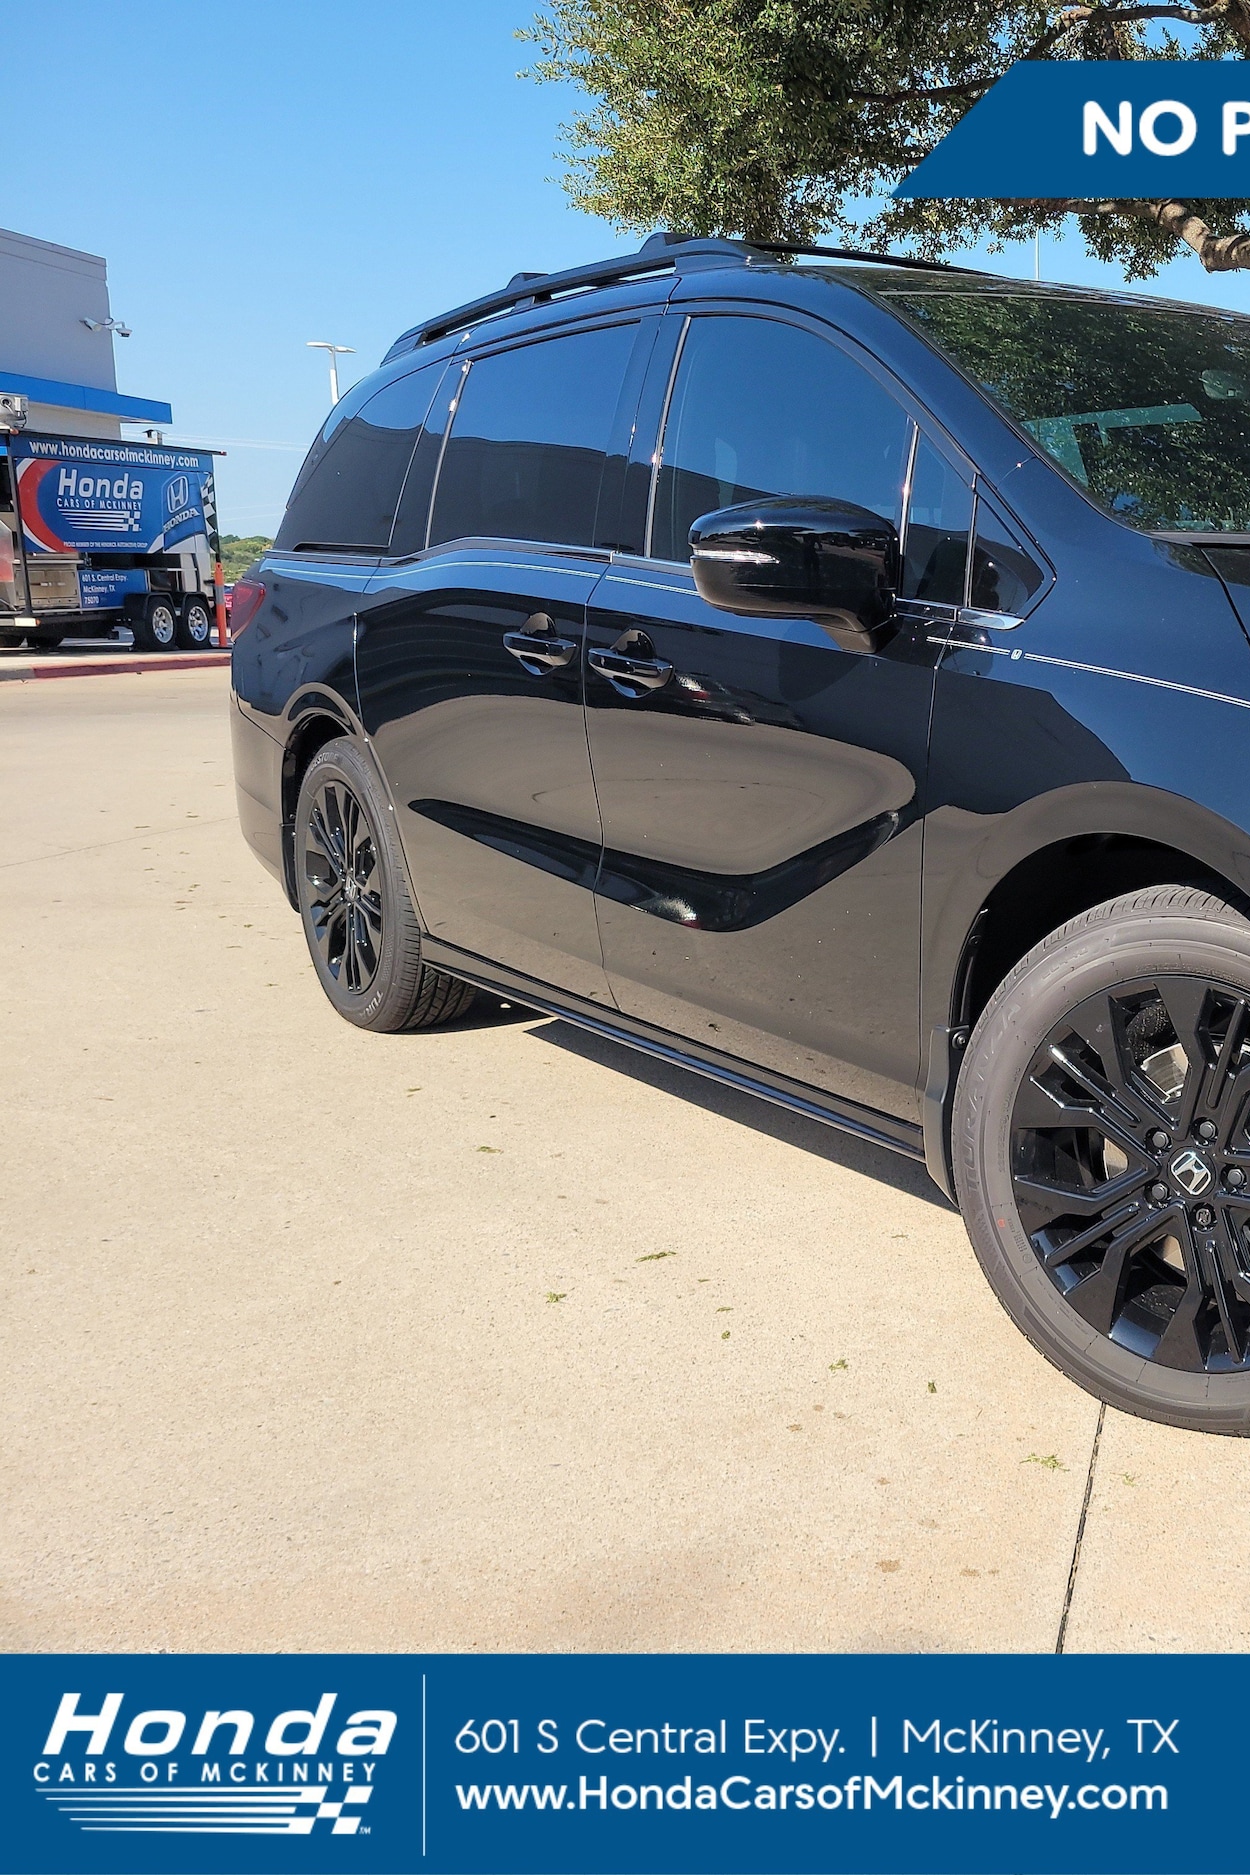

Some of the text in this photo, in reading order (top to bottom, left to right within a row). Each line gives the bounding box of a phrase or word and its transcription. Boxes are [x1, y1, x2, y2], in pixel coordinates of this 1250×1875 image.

[29, 440, 199, 468] www.hondacarsofmckinney.com
[57, 468, 143, 500] Honda
[57, 498, 142, 510] CARS OF MCKINNEY
[163, 507, 200, 534] HONDA
